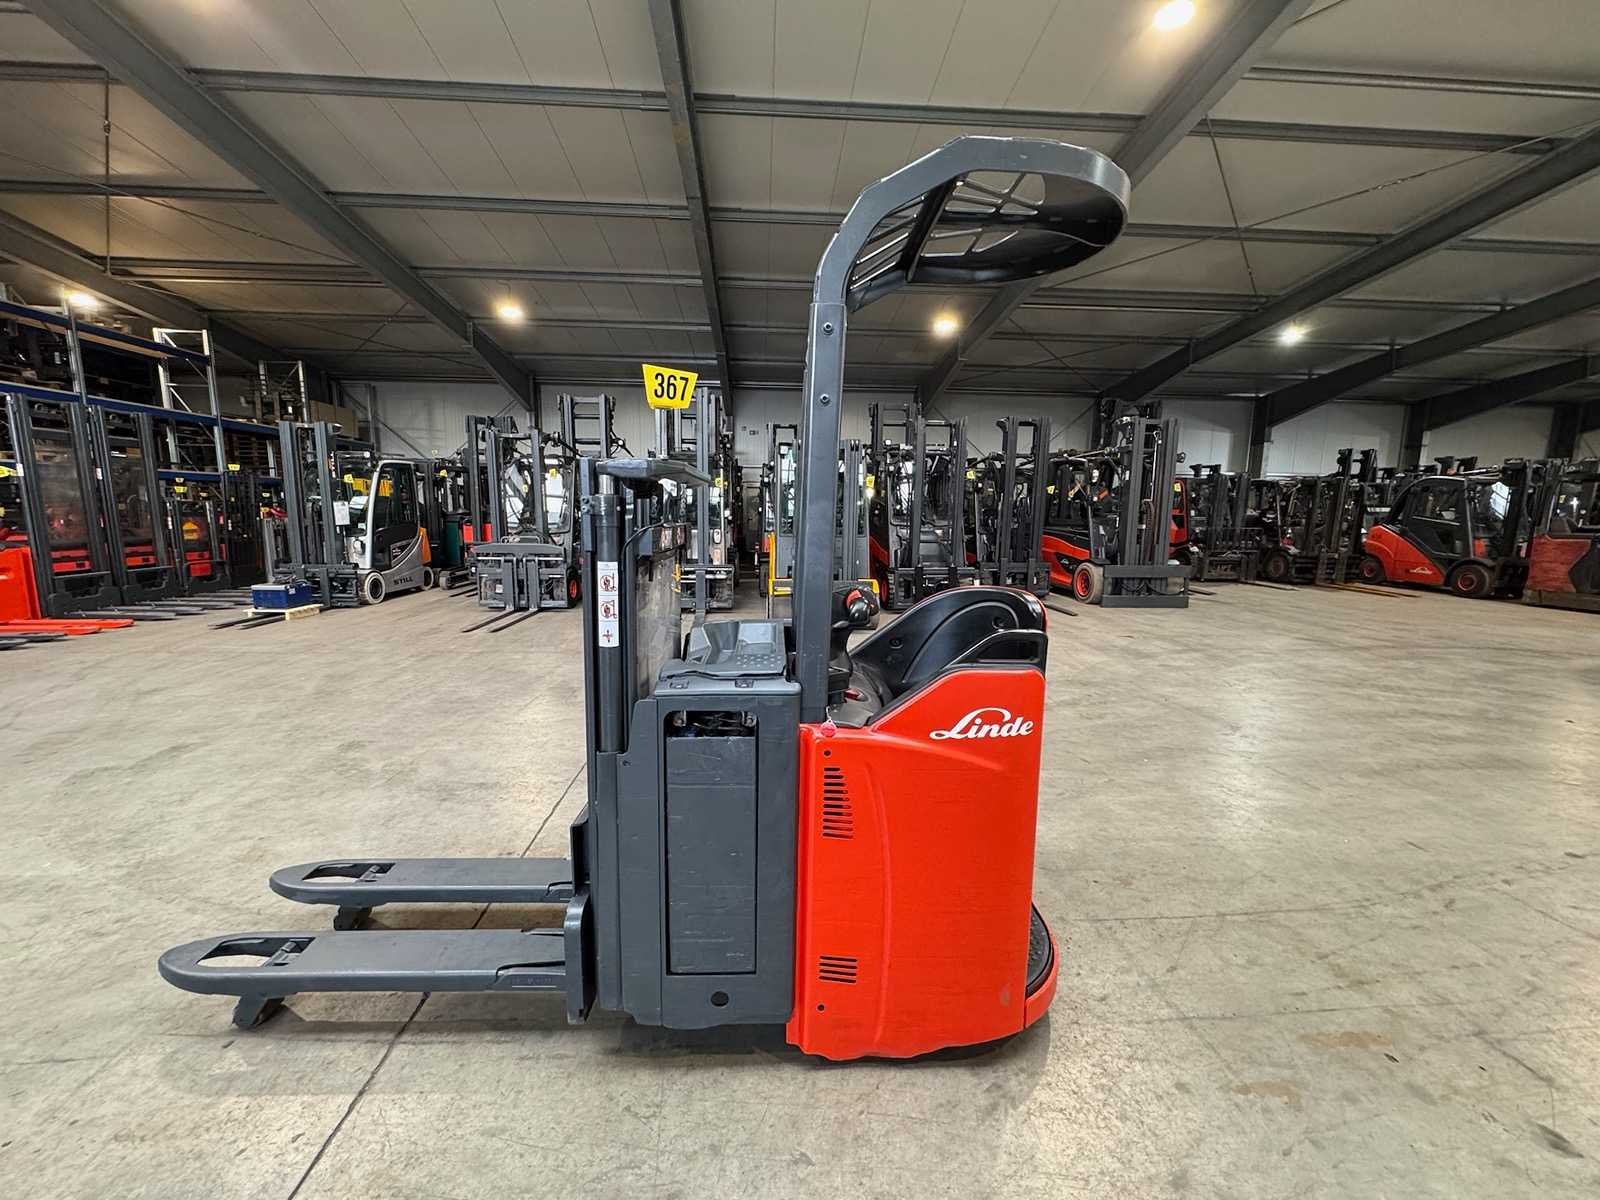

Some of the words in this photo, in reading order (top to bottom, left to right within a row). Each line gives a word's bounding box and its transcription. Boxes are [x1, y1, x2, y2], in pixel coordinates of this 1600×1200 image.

[654, 372, 689, 401] 367
[393, 576, 414, 586] STILL
[929, 707, 1034, 740] Linde
